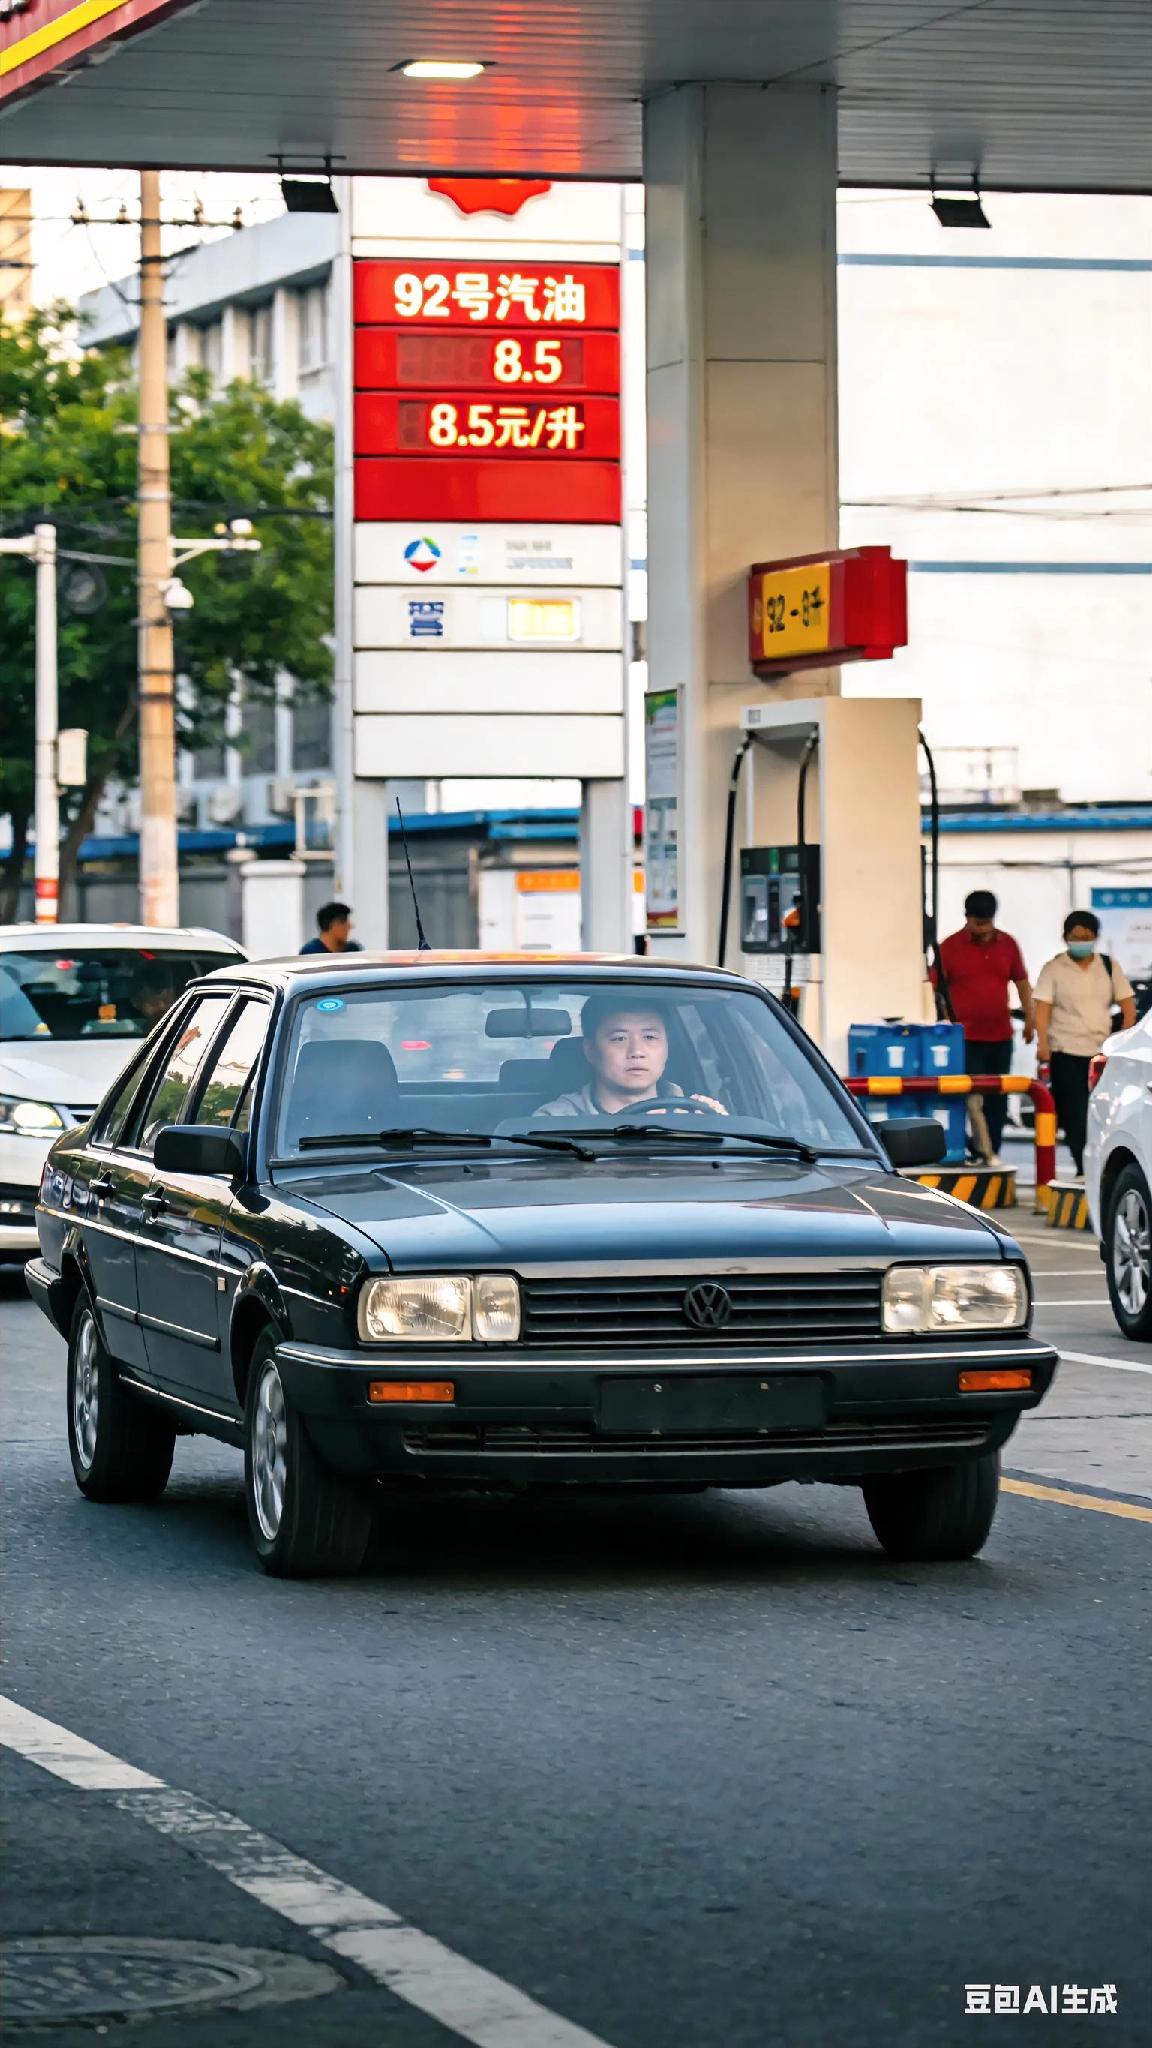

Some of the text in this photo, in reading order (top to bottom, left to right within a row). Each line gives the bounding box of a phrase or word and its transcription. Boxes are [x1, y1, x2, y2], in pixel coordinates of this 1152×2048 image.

[393, 272, 586, 322] 92号汽油
[493, 339, 563, 384] 8.5
[428, 403, 585, 450] 8.5元/升
